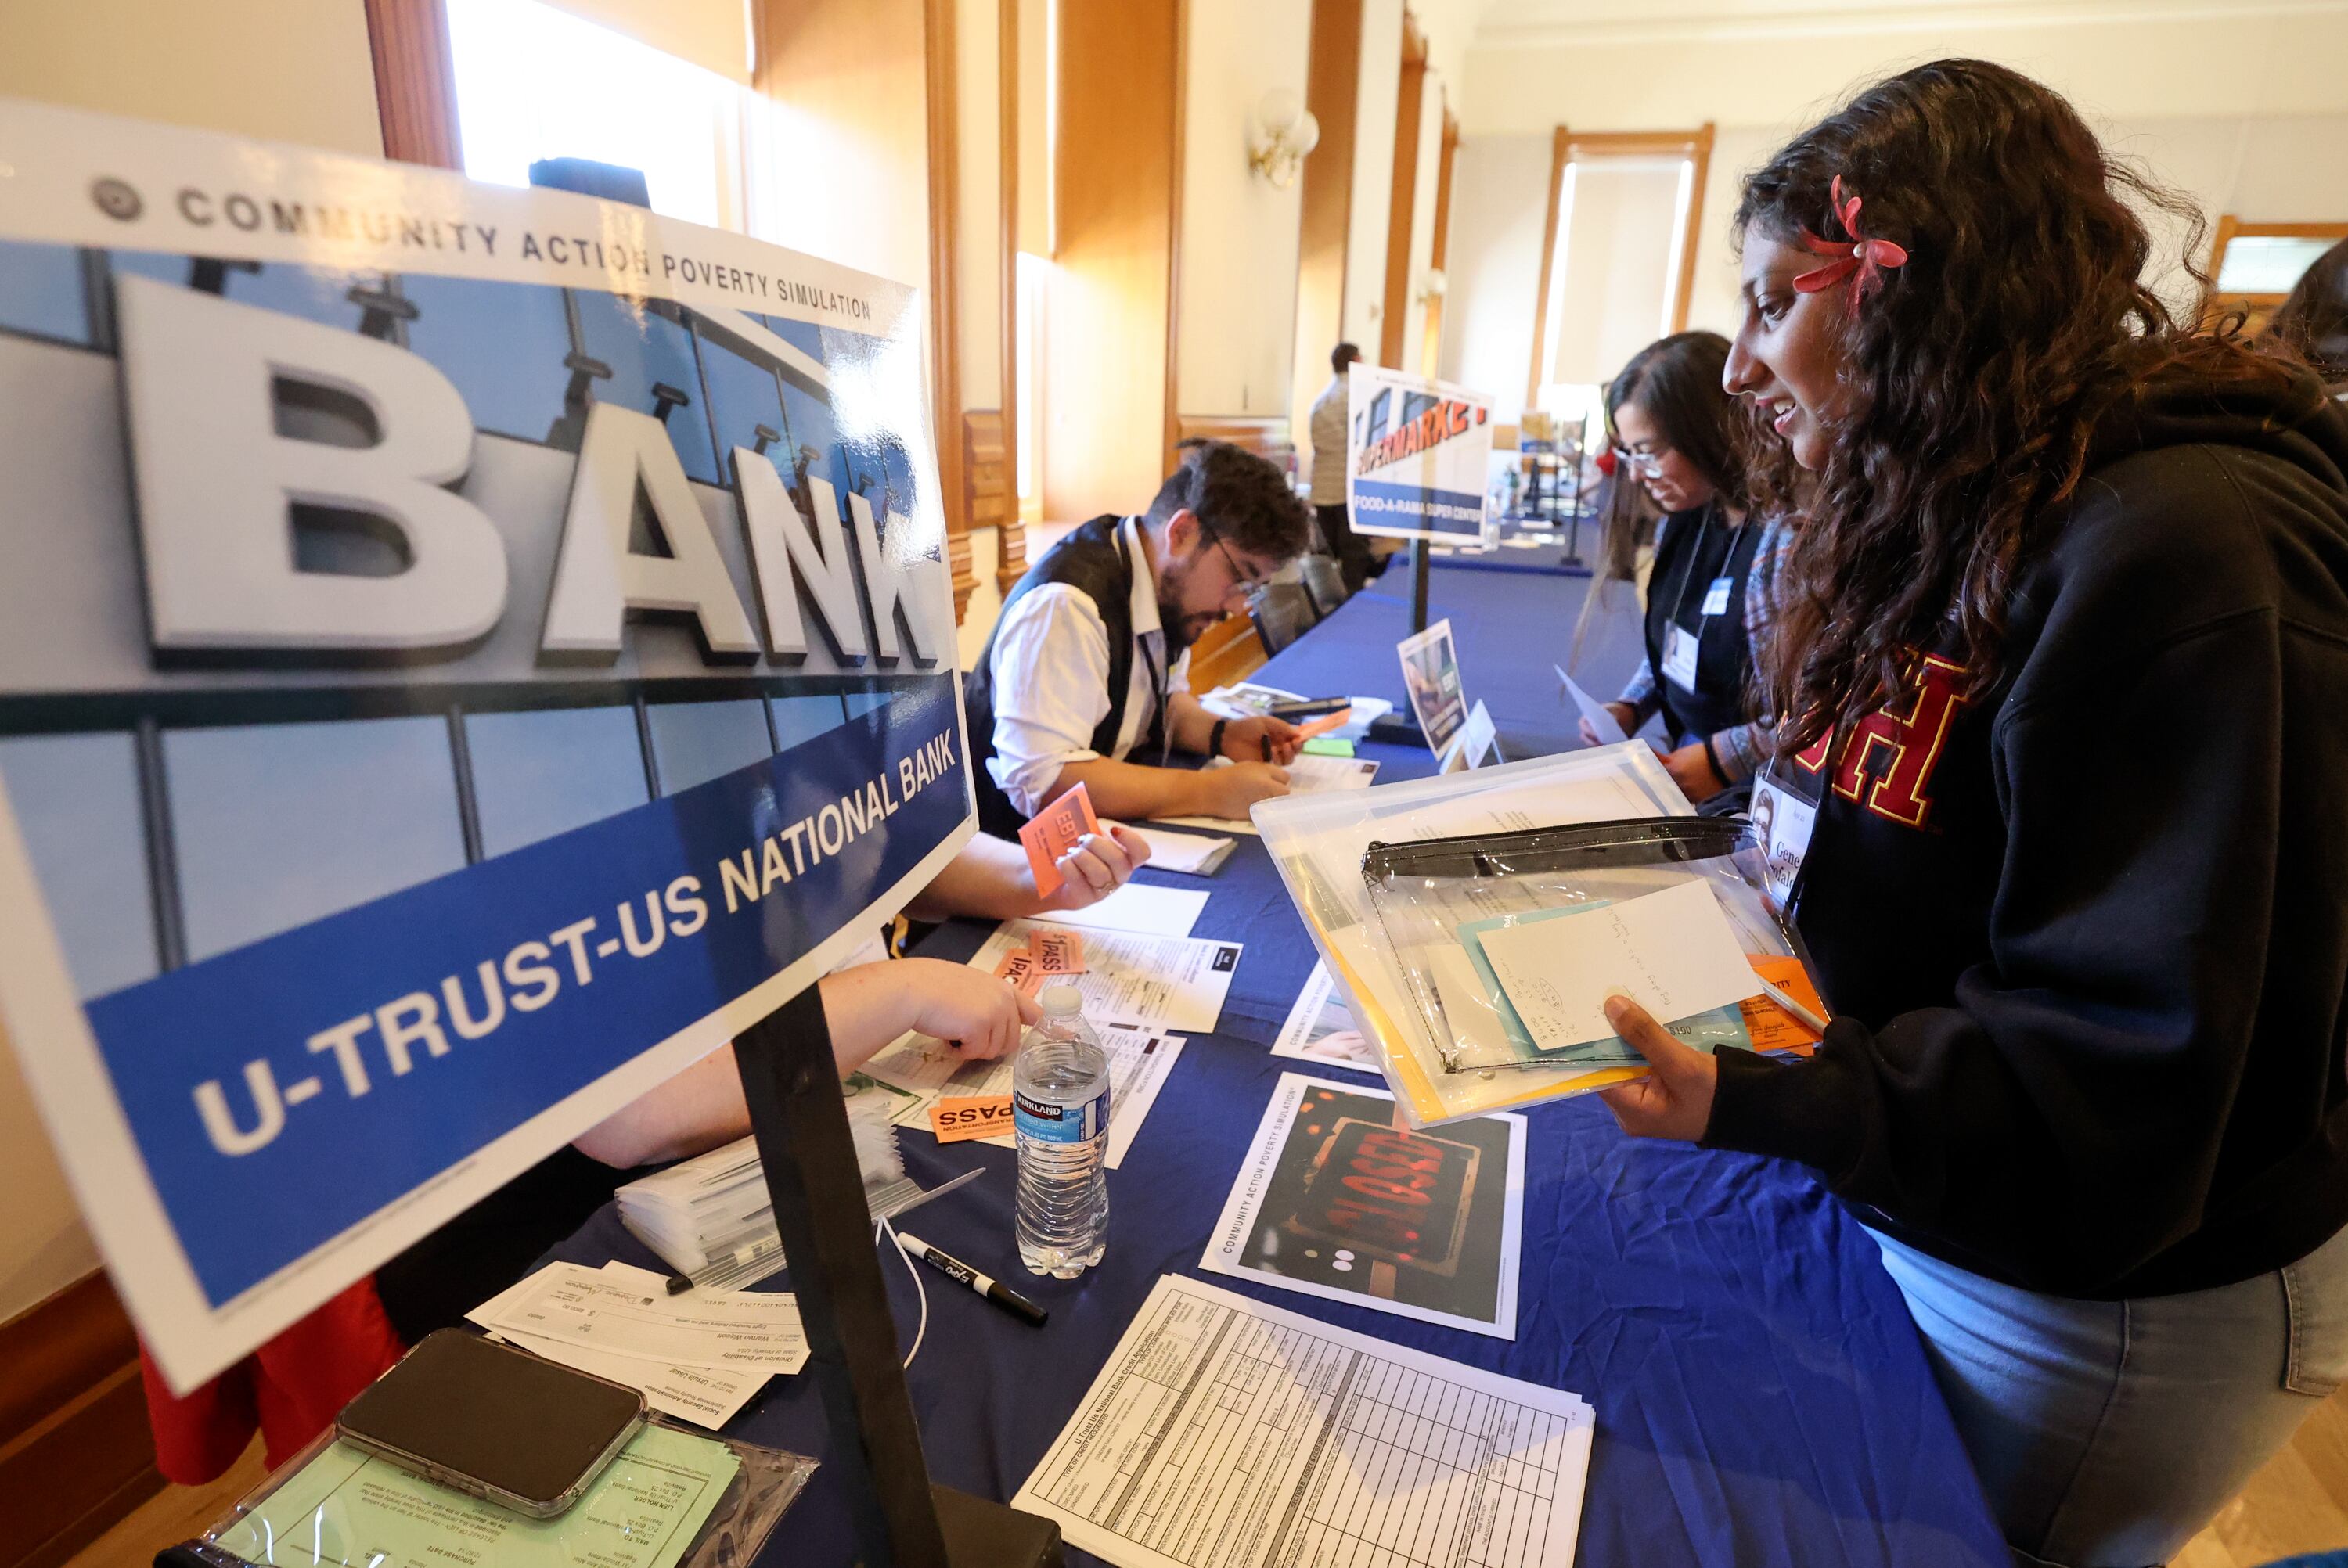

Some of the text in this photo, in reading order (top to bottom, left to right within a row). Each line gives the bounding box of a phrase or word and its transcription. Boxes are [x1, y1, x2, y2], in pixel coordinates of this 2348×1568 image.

[176, 187, 871, 322] COMMUNITY ACTION POVERTY SIMULATION
[115, 268, 942, 667] BANK
[192, 728, 956, 1156] U-TRUST-US NATIONAL BANK
[1042, 944, 1061, 970] PASS
[1001, 958, 1027, 986] PA
[1287, 974, 1330, 1046] COMMUNITY ACTION POVERTY
[938, 1102, 1014, 1125] PASS
[1017, 1096, 1061, 1116] KIRKLAND
[1222, 1088, 1296, 1254] COMMUNITY ACTION POVERTY SIMULATION
[943, 1262, 971, 1284] EXPO
[668, 1366, 708, 1386] Ursula Ussar
[1078, 1421, 1093, 1438] Trust
[1089, 1412, 1099, 1422] Us
[1095, 1389, 1115, 1413] National
[1111, 1375, 1125, 1389] Bank
[1120, 1358, 1136, 1375] Credit
[1132, 1329, 1156, 1358] Application
[644, 1383, 720, 1416] Social Security Administration
[1063, 1464, 1075, 1477] TYPE
[1075, 1440, 1091, 1458] CREDIT
[1087, 1412, 1110, 1440] REQUESTED
[1290, 1485, 1304, 1508] SECTION
[1302, 1461, 1314, 1478] ASSET
[1311, 1444, 1321, 1458] DEBT
[1316, 1413, 1334, 1444] INFORMATION
[633, 1494, 673, 1511] LIEN HOLDER
[633, 1536, 649, 1546] MAIL
[1216, 1526, 1231, 1548] ADDRESS
[1251, 1539, 1262, 1556] OTHER
[1258, 1521, 1270, 1540] INCOME
[426, 1545, 476, 1566] PURCHASE DATE
